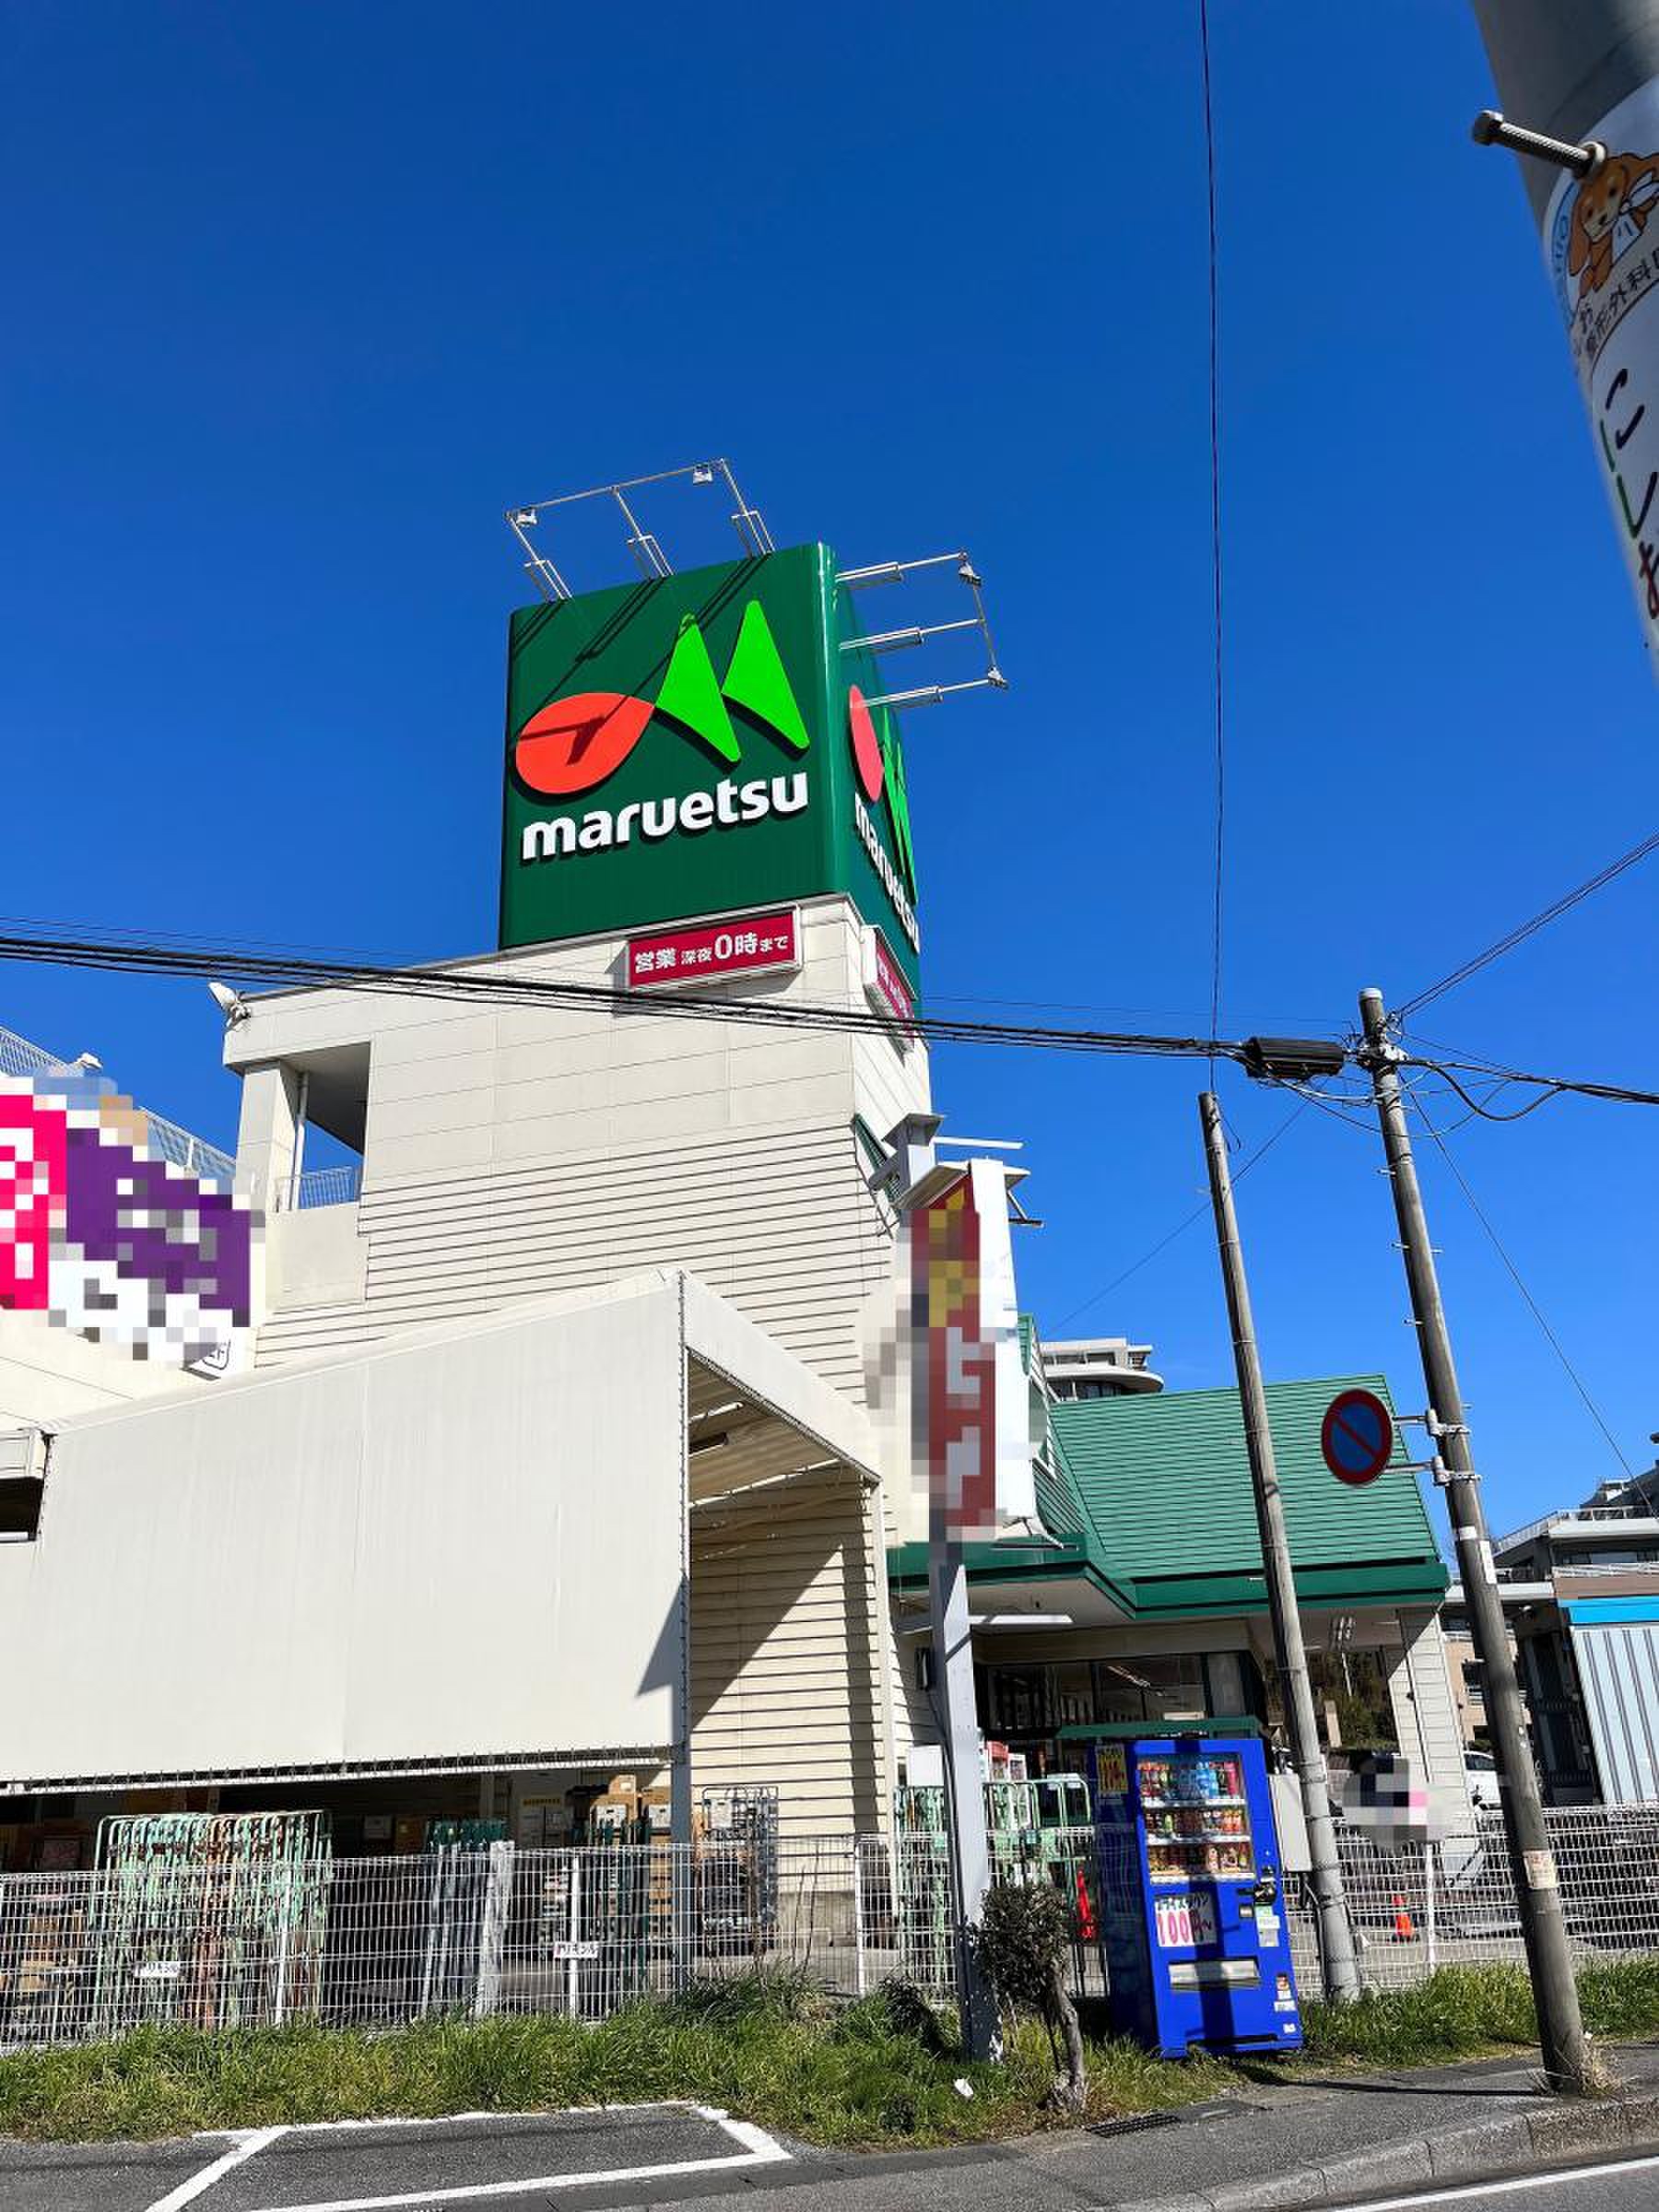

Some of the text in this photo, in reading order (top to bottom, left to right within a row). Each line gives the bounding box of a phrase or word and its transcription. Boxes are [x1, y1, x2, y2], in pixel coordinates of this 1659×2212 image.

[522, 771, 809, 860] maruetsu
[854, 791, 920, 955] maruetsu
[635, 947, 677, 973] 営業
